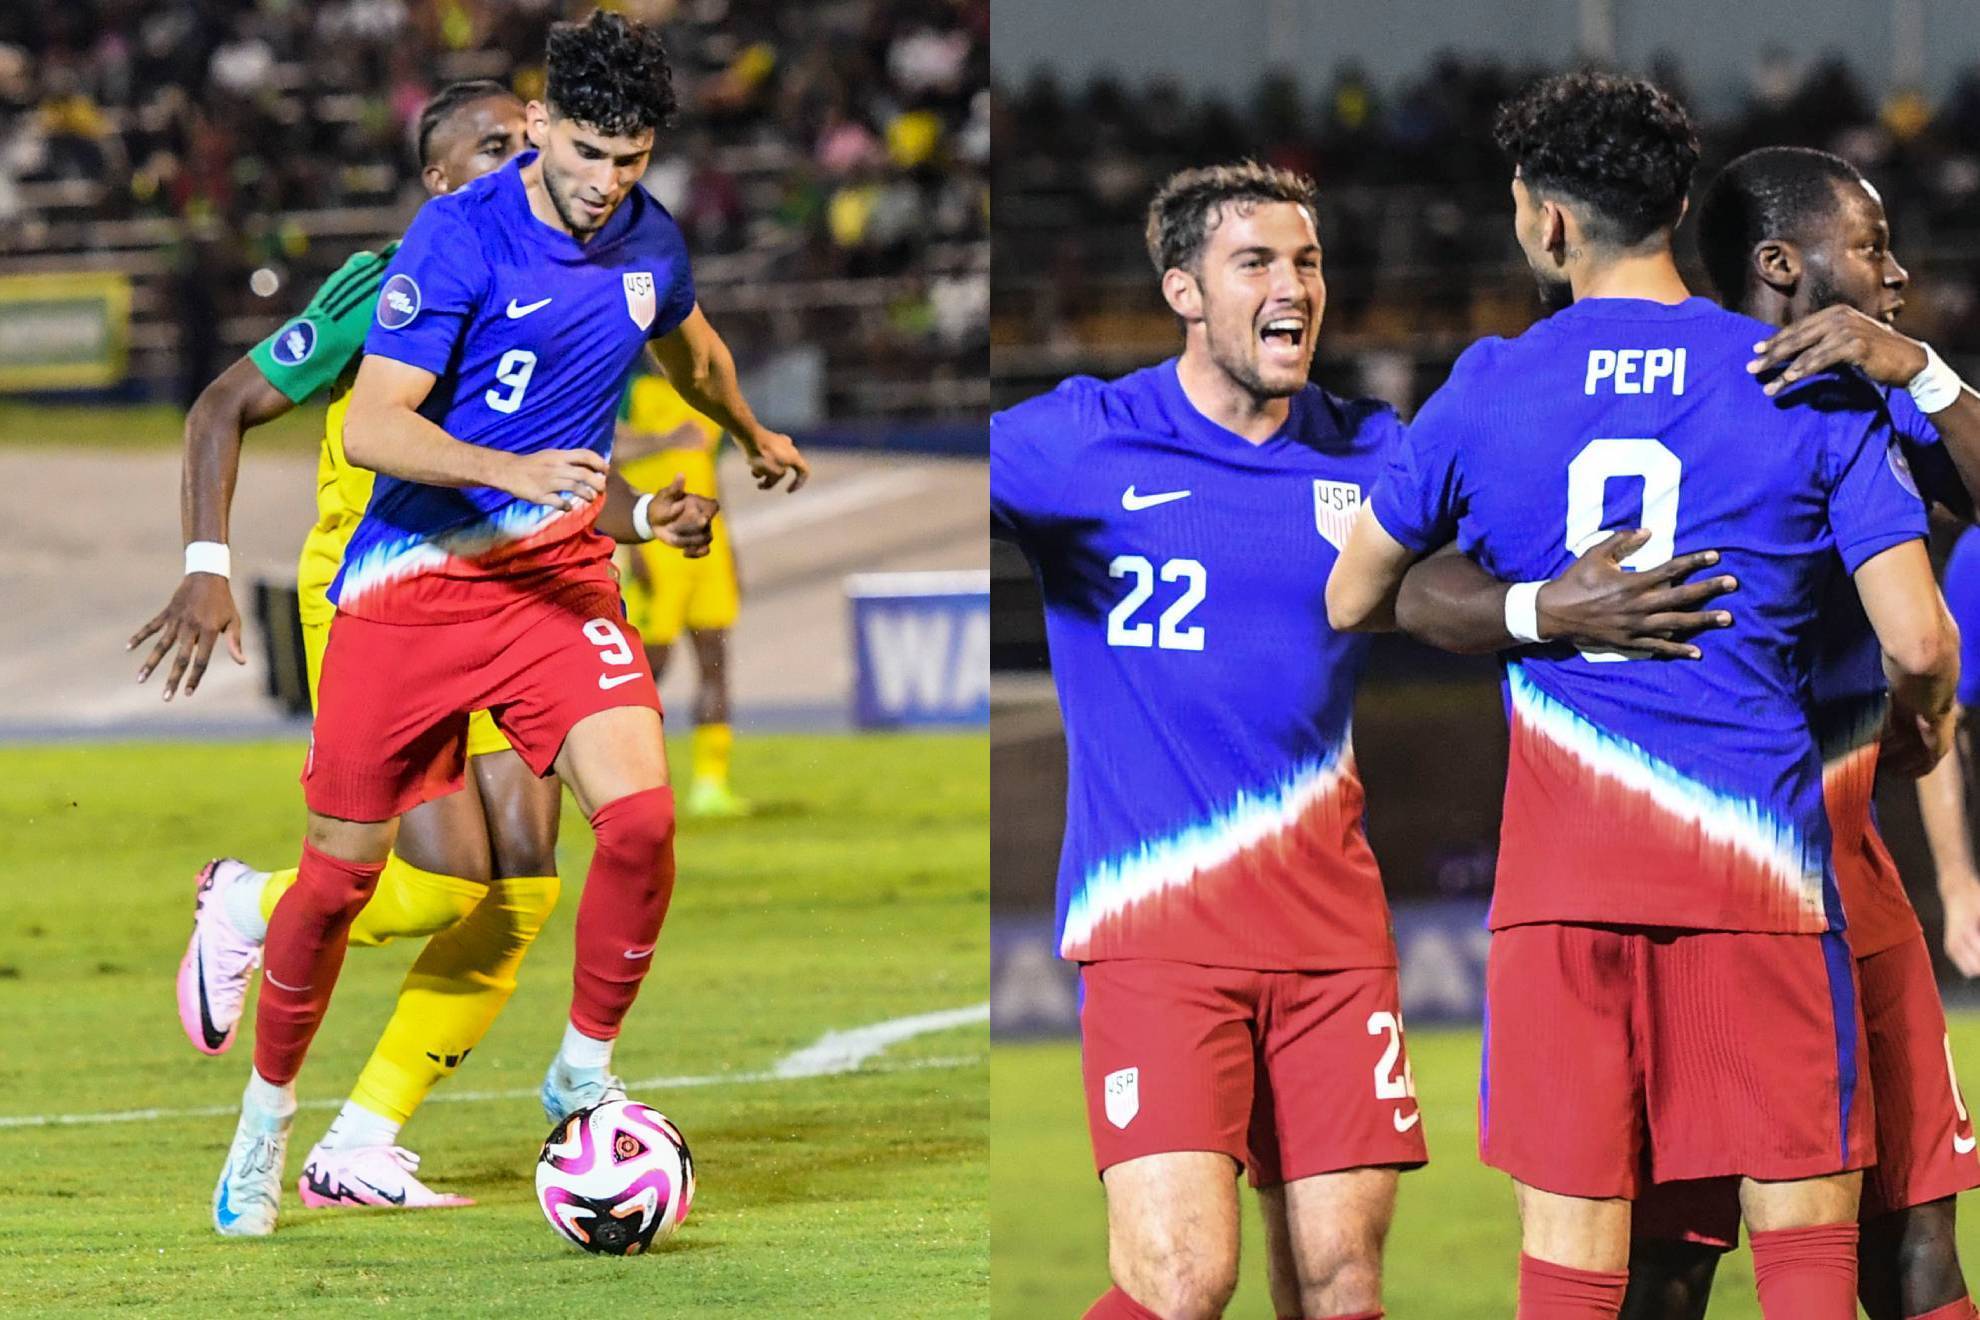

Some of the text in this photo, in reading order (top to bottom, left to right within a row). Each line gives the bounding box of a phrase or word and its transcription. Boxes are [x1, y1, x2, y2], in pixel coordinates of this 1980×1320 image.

[626, 276, 651, 296] USA
[485, 349, 537, 414] 9
[1584, 347, 1687, 396] PEPI
[1318, 486, 1356, 511] USA
[1107, 555, 1207, 651] 22
[582, 617, 634, 665] 9
[1366, 1011, 1416, 1099] 2
